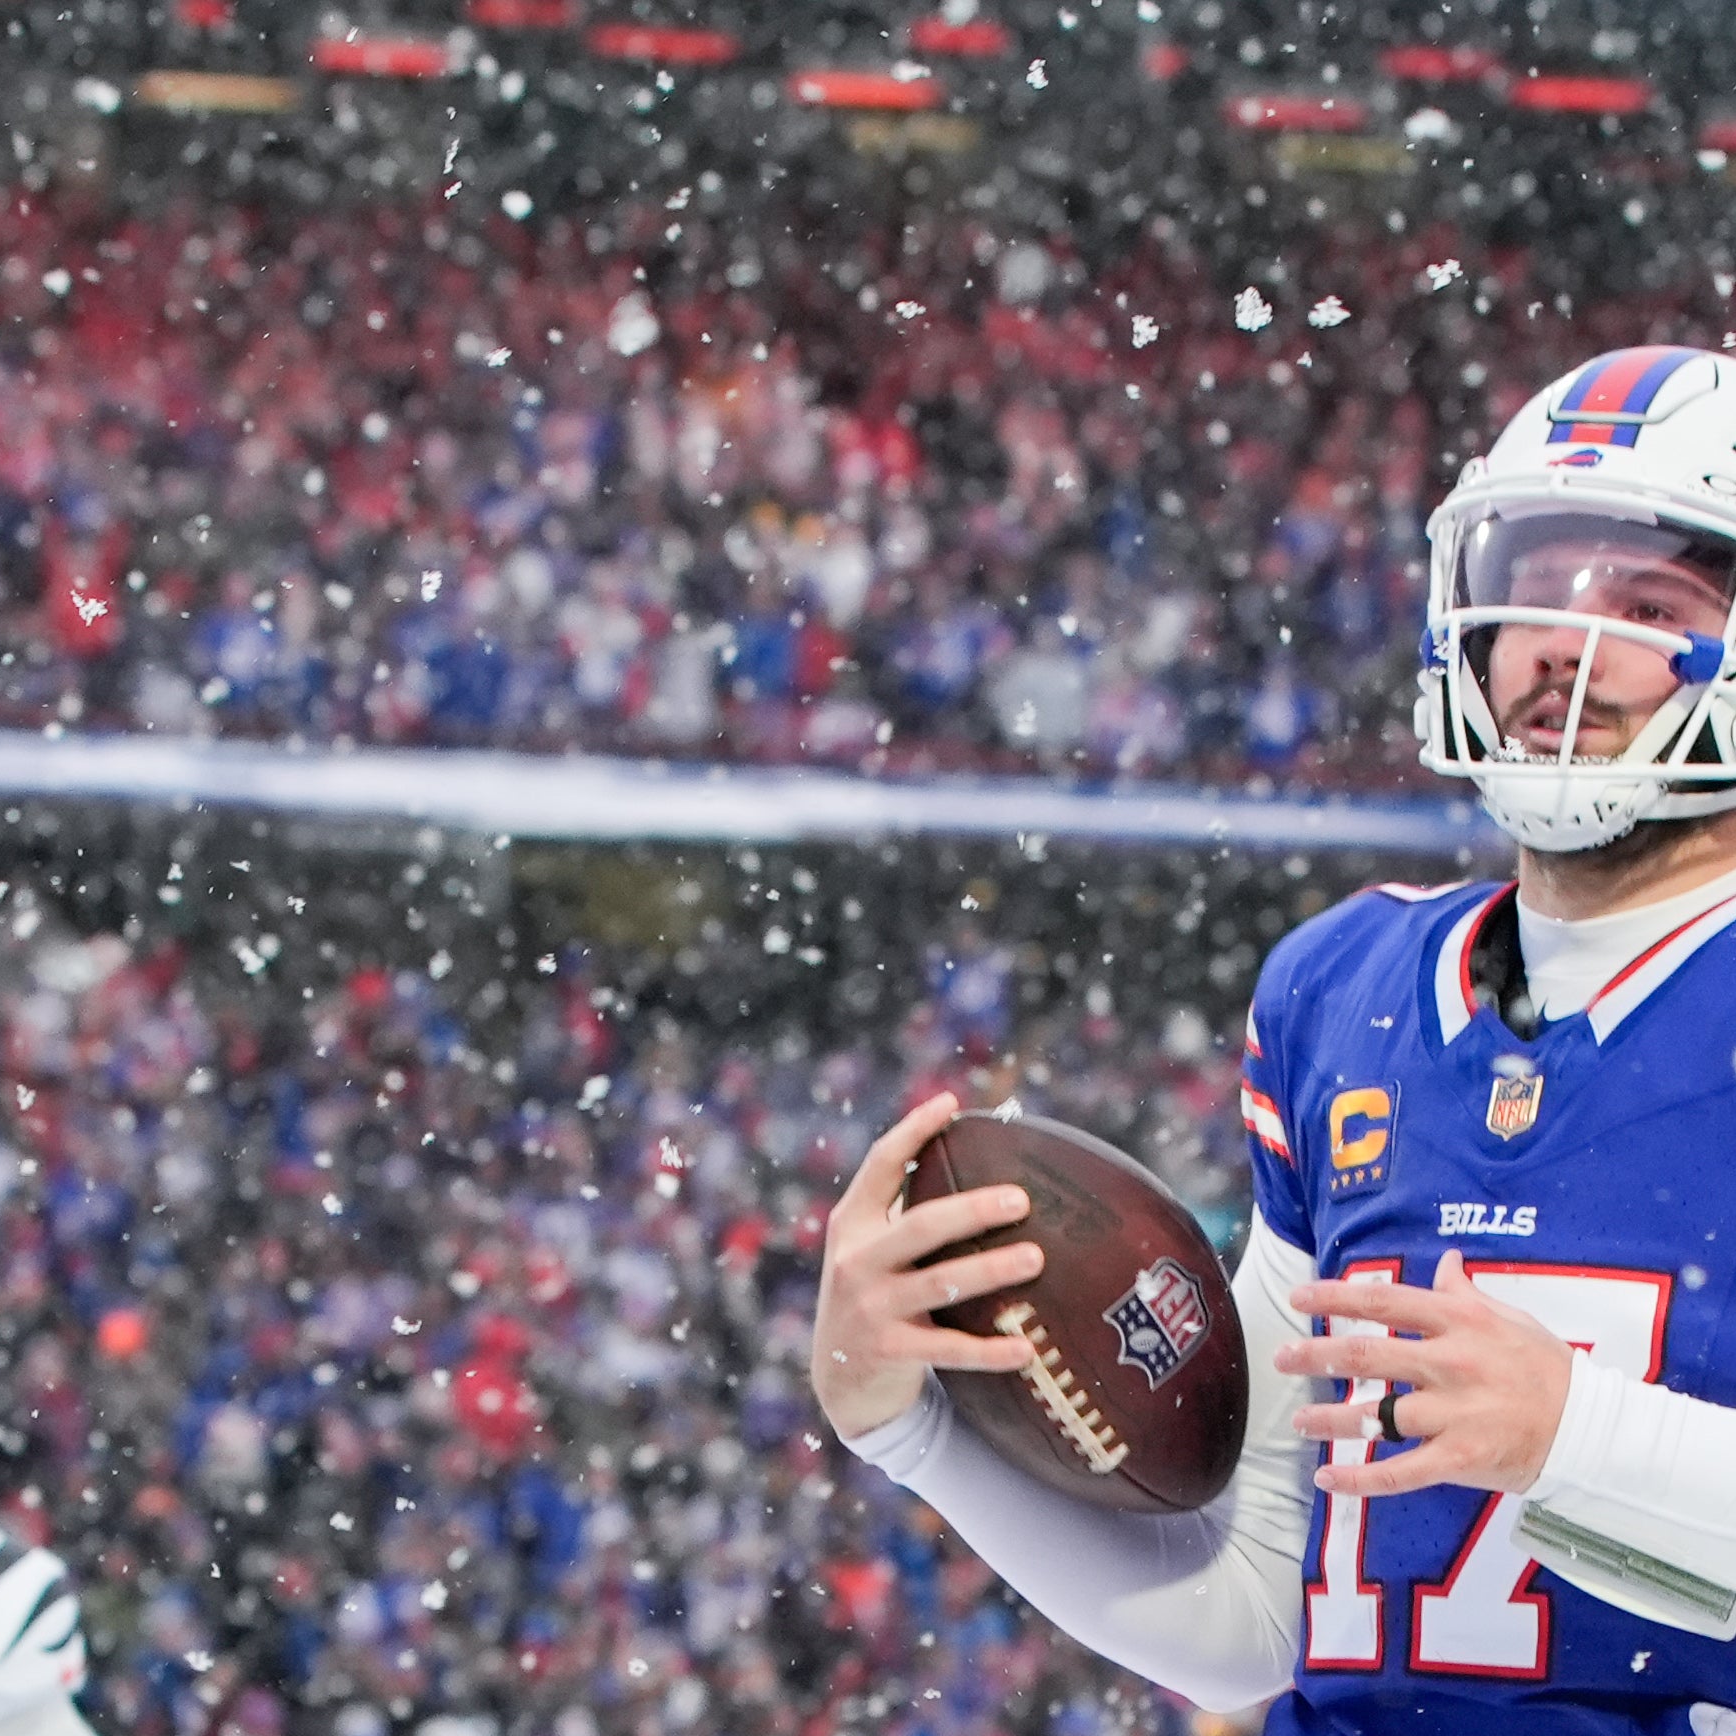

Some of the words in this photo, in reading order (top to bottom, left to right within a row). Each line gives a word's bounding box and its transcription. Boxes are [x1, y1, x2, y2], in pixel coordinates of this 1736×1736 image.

[1329, 1087, 1391, 1170] C
[1437, 1203, 1538, 1237] BILLS
[1303, 1256, 1676, 1682] 17
